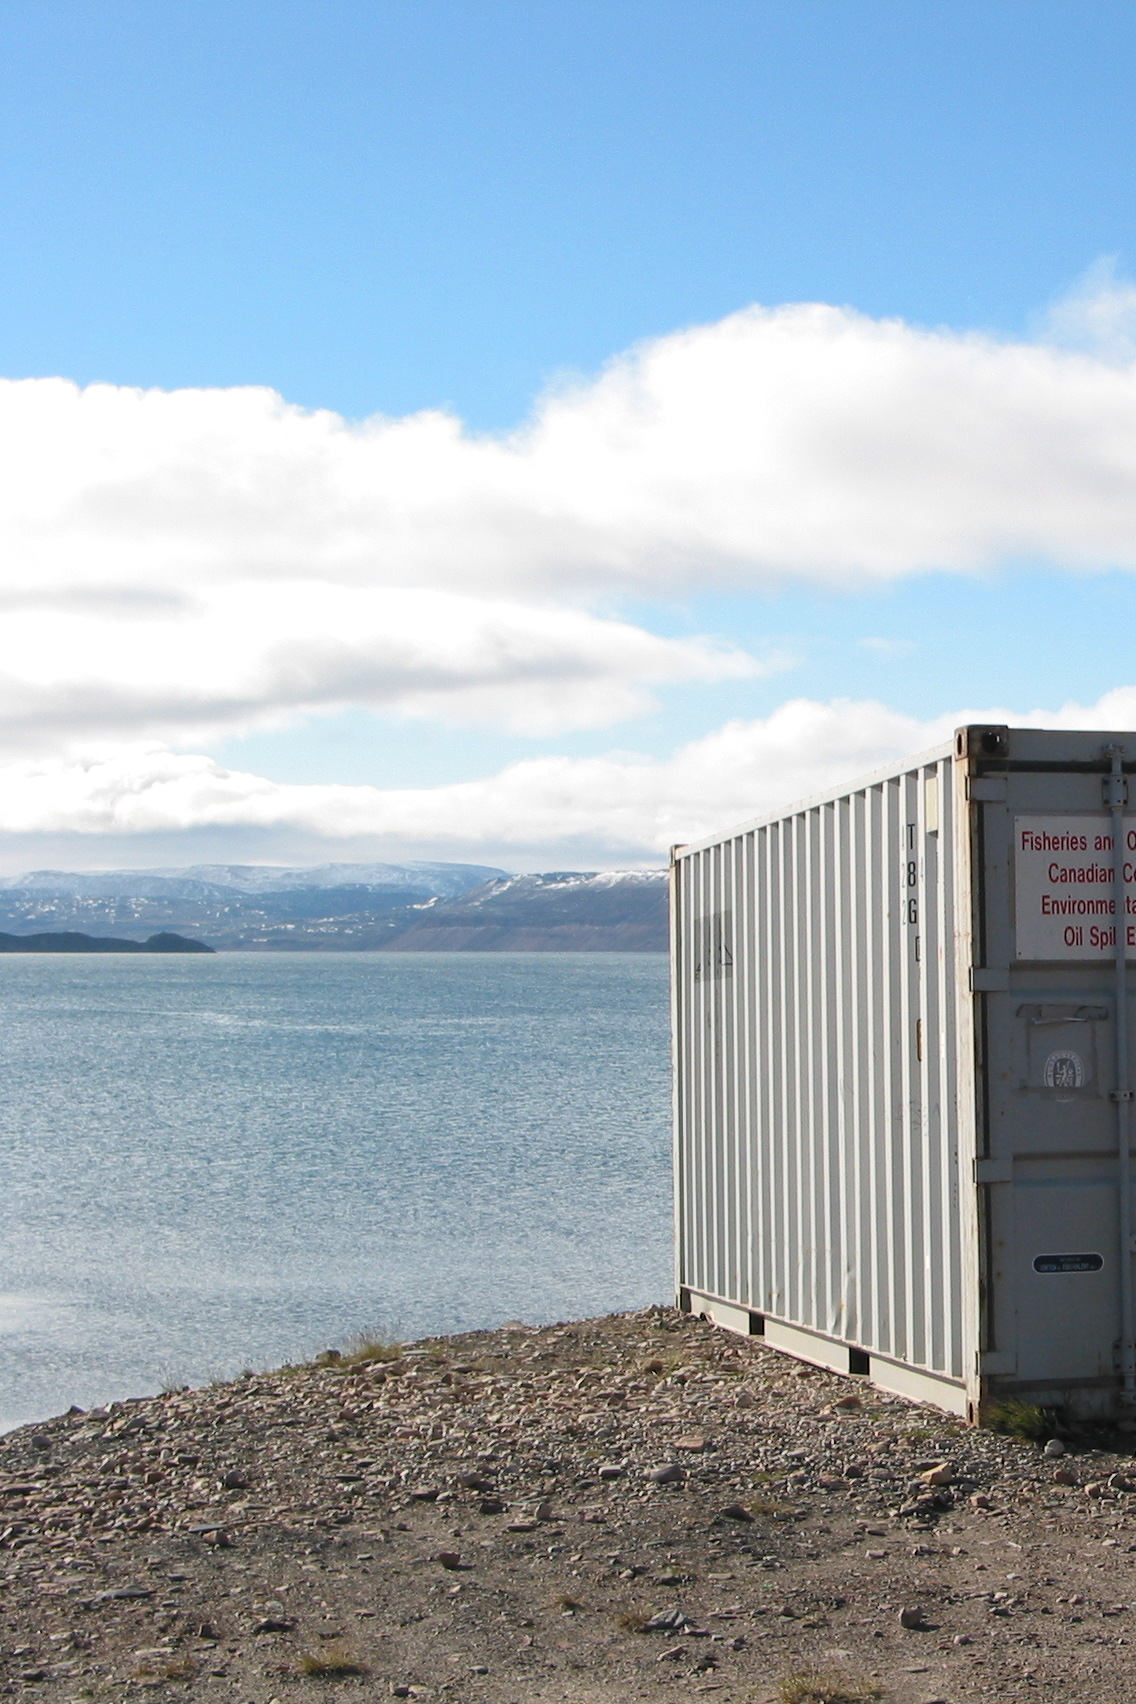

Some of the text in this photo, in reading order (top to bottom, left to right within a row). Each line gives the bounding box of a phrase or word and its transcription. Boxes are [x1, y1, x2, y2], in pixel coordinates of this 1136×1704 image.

[1021, 830, 1088, 851] Fisheries
[1094, 834, 1116, 851] an
[1048, 863, 1115, 883] Canadian
[1063, 926, 1084, 947] Oil
[1089, 926, 1116, 950] Spil
